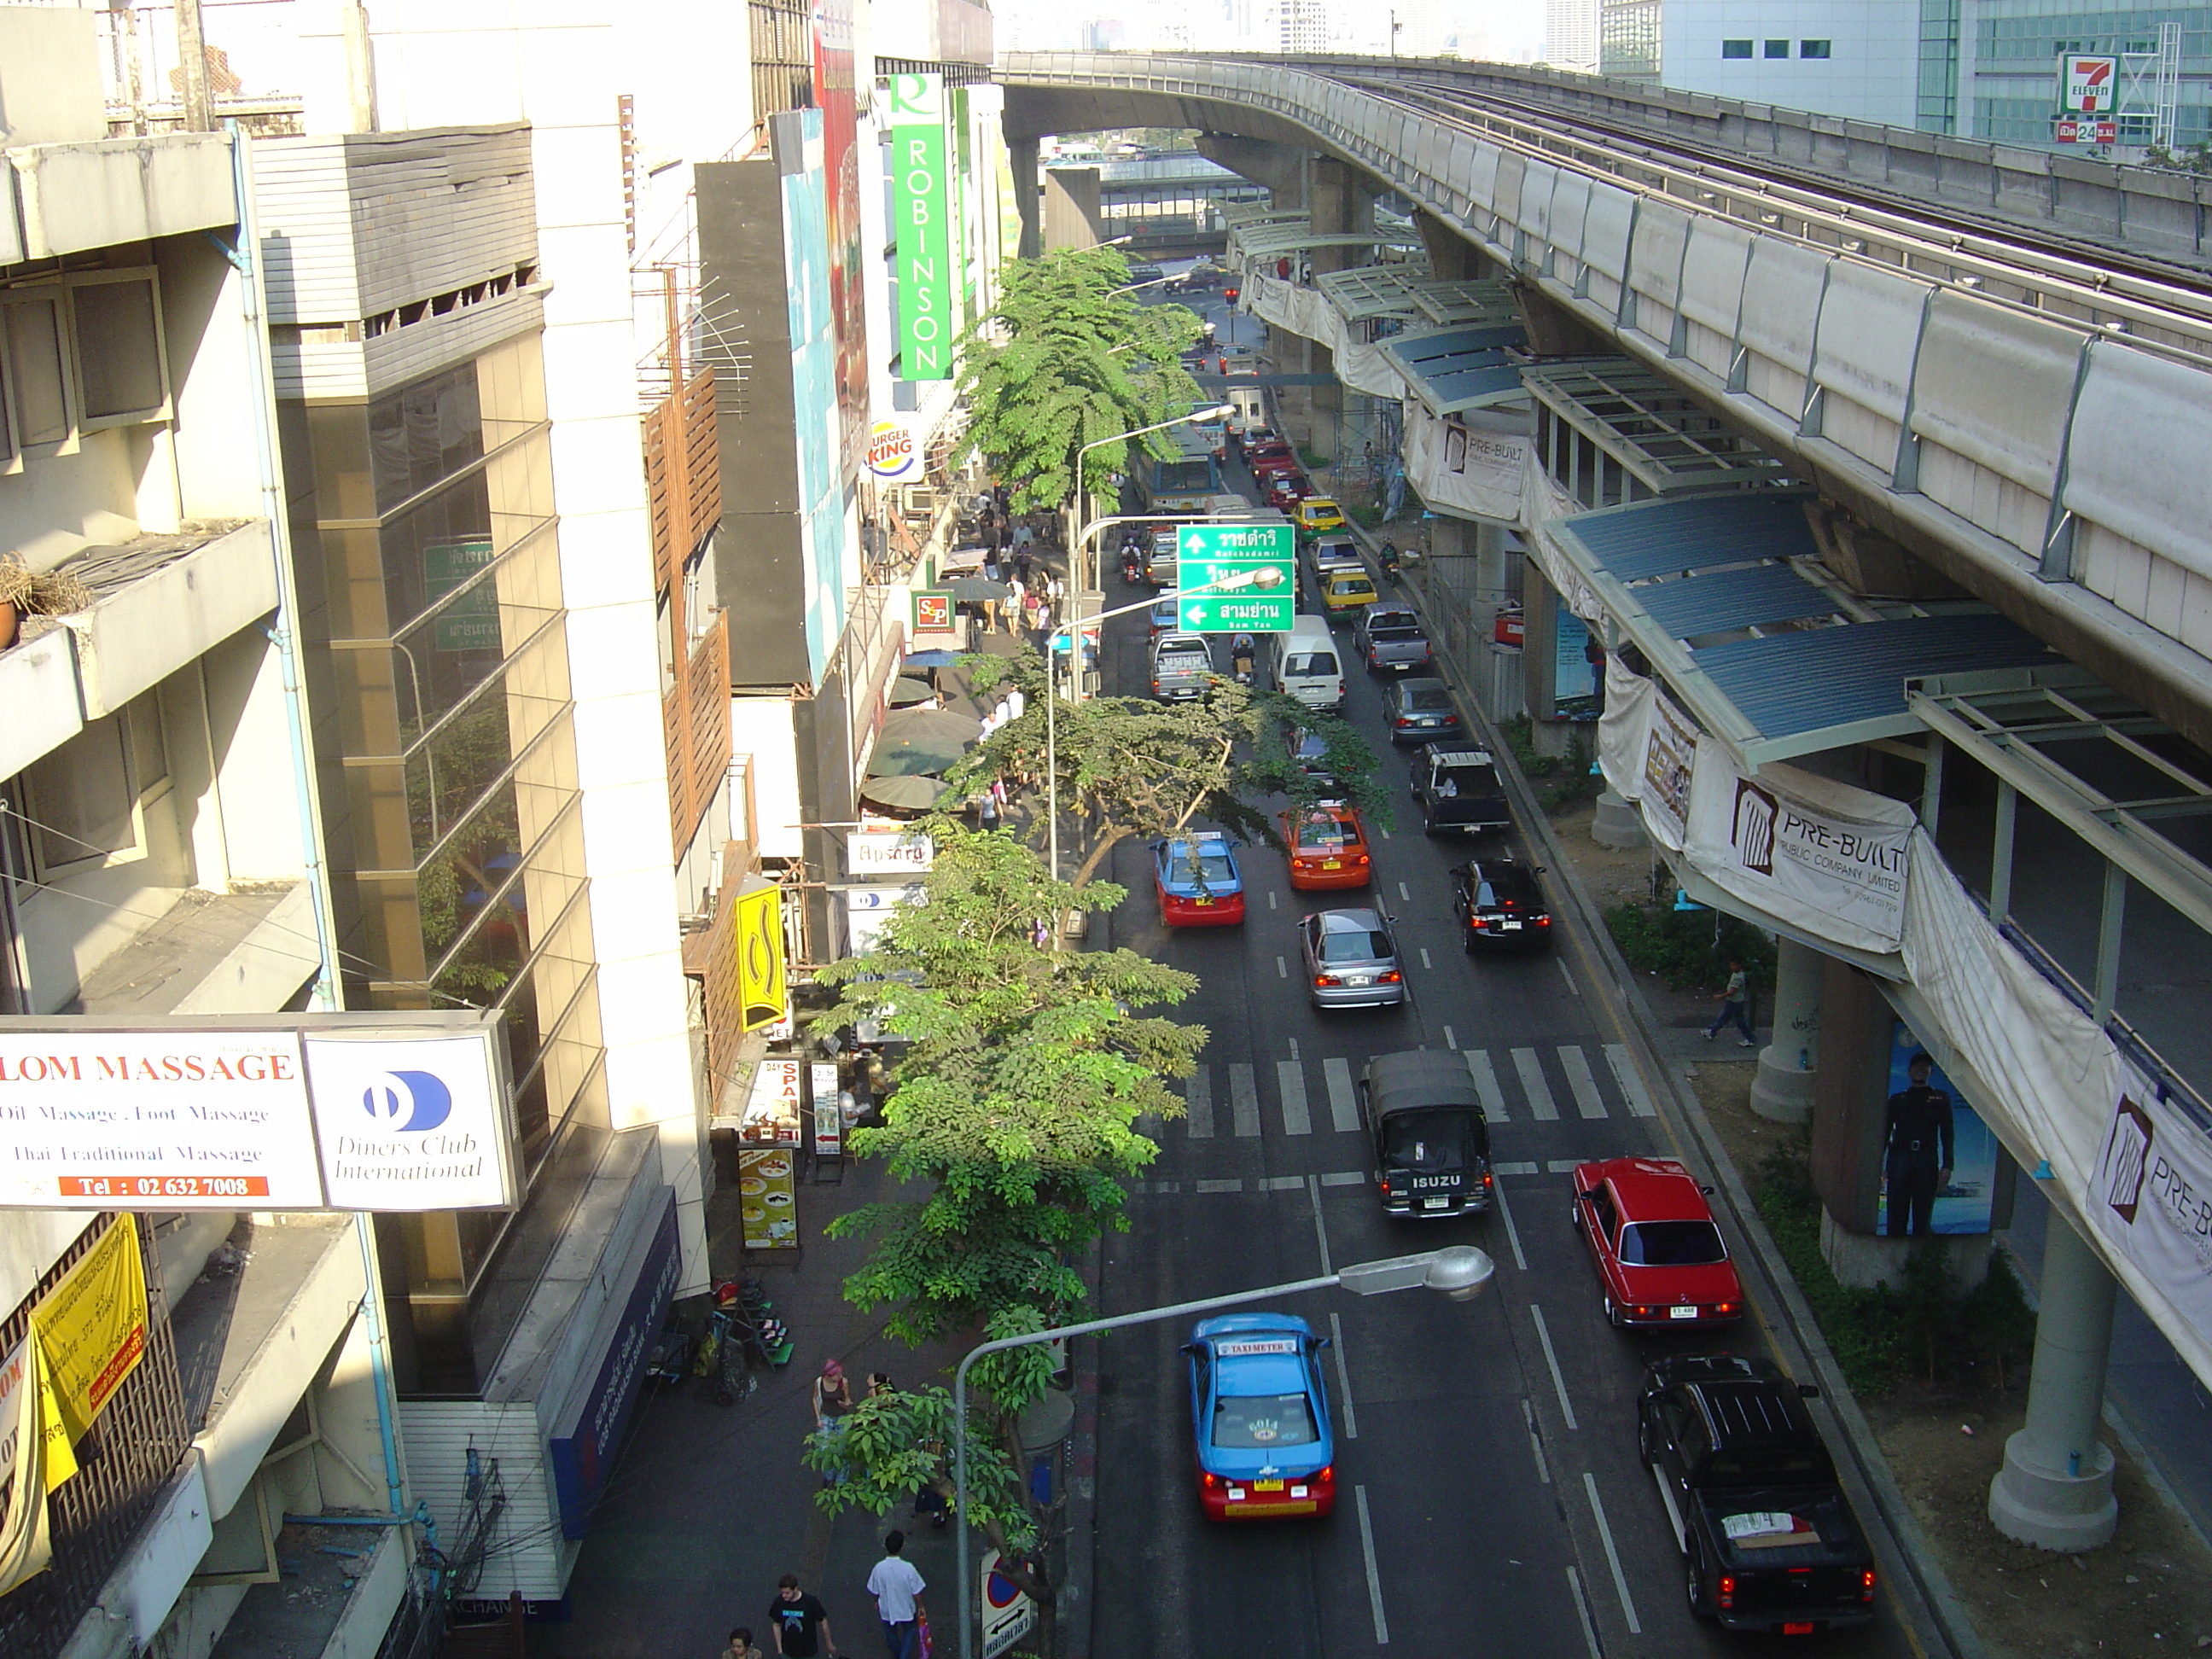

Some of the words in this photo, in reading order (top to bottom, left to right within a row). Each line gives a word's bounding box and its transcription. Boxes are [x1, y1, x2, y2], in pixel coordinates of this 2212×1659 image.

[2075, 61, 2110, 111] 7
[2078, 125, 2096, 140] 24
[906, 138, 938, 370] ROBINSON
[872, 428, 911, 448] URGER
[1469, 437, 1523, 462] PRE-BUILT
[868, 441, 912, 467] KING
[1218, 528, 1277, 547] ราชดำริ
[1220, 601, 1280, 619] สามย่าน
[1783, 812, 1905, 873] PRE-BUILT
[1781, 840, 1812, 861] PUBLIC
[1813, 853, 1863, 880] COMPANY
[1867, 872, 1901, 893] LIMITED
[96, 1053, 295, 1081] MASSAGE
[783, 1062, 797, 1097] SPA
[38, 1106, 118, 1124] Massage
[189, 1106, 271, 1124] Massage
[14, 1145, 51, 1161] Thai
[61, 1145, 164, 1161] Traditional
[176, 1145, 263, 1164] Massage
[337, 1135, 410, 1157] Diners
[420, 1132, 478, 1155] Club
[334, 1156, 483, 1181] International
[78, 1178, 112, 1196] Tel
[137, 1178, 161, 1196] 02
[164, 1178, 200, 1196] 632
[201, 1177, 249, 1196] 7008
[1412, 1174, 1461, 1189] ISUZU
